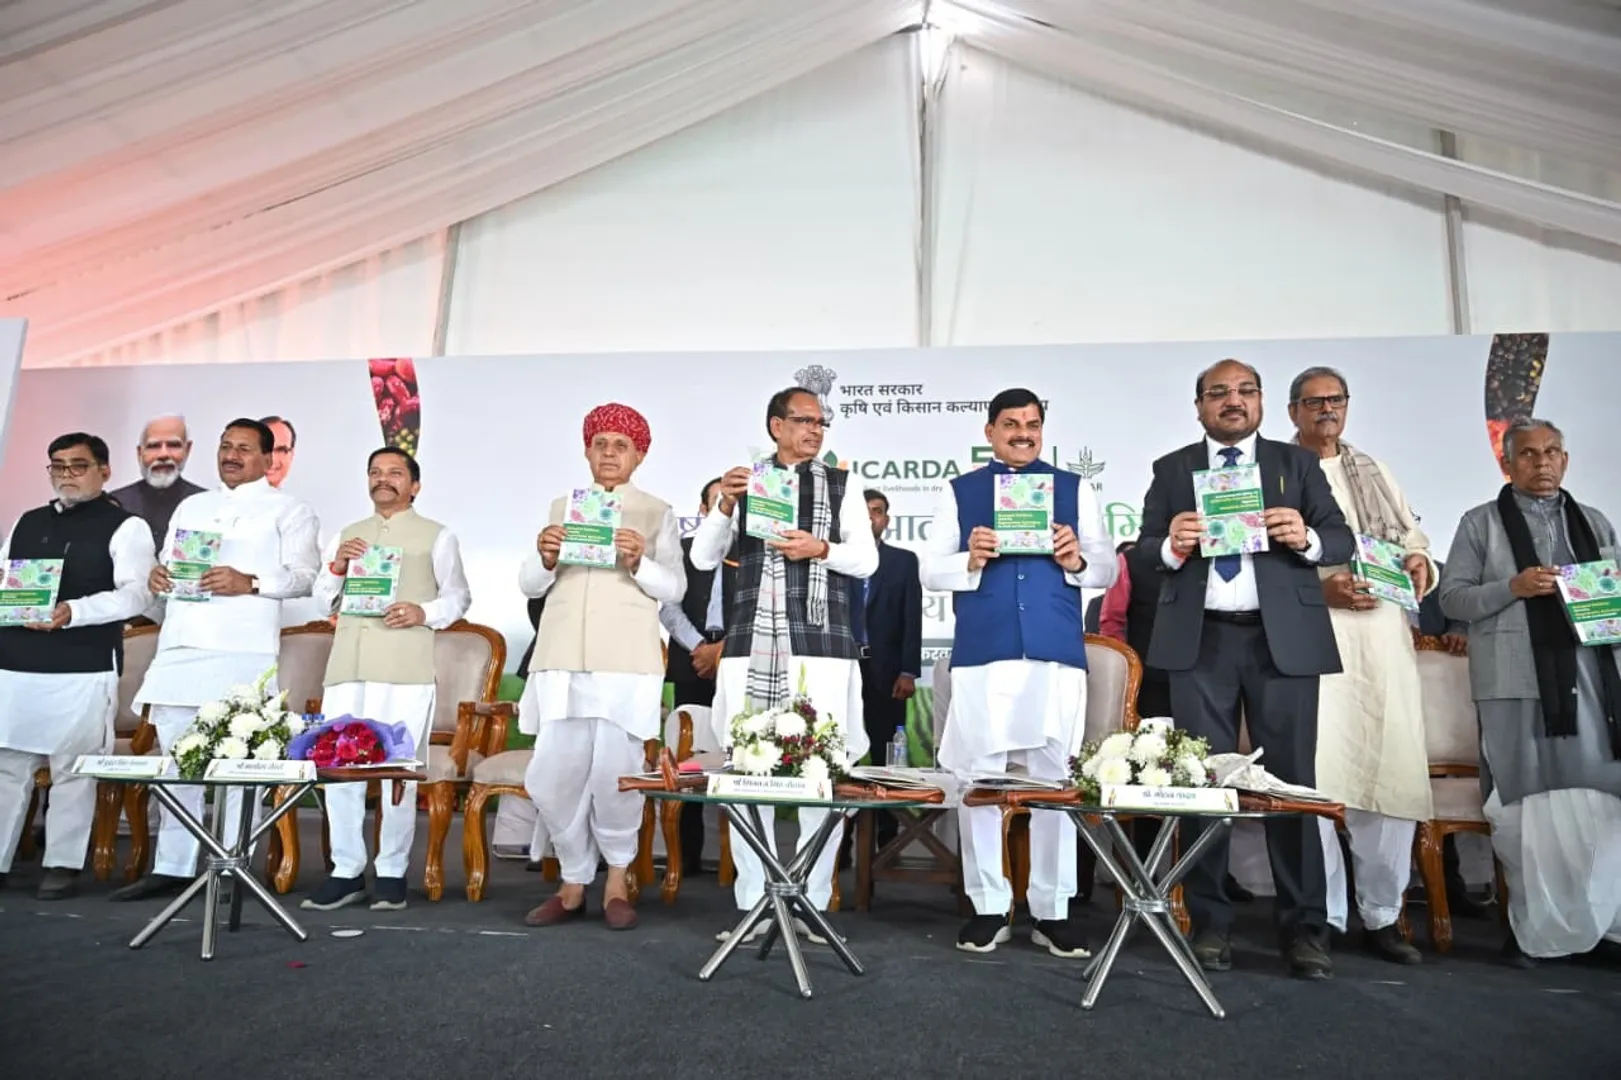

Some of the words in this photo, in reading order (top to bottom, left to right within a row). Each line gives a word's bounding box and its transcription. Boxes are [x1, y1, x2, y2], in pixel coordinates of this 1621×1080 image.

[840, 385, 874, 397] भारत
[878, 384, 923, 396] सरकार
[840, 400, 868, 418] कृषि
[873, 400, 892, 416] एवं
[897, 399, 941, 414] किसान
[853, 460, 960, 479] ICARDA
